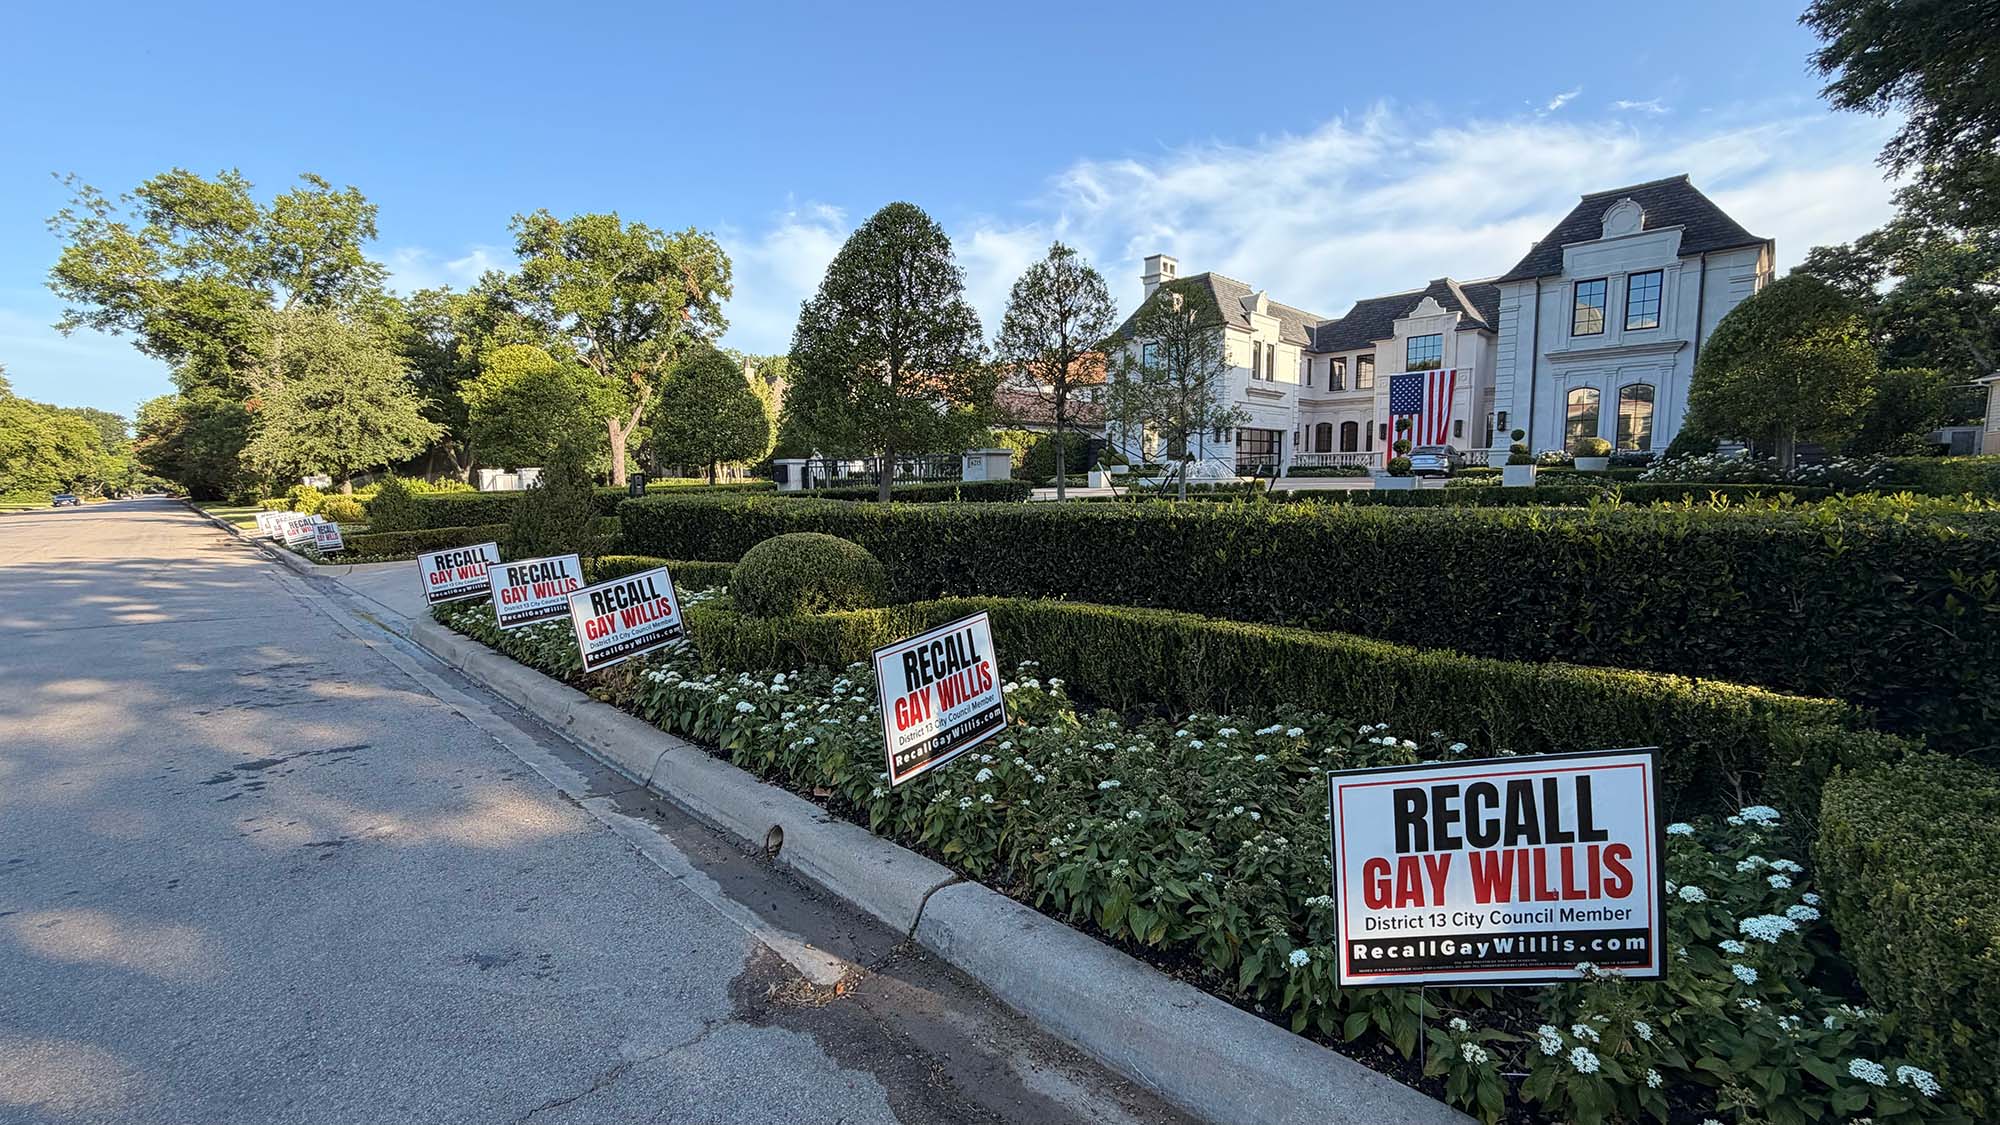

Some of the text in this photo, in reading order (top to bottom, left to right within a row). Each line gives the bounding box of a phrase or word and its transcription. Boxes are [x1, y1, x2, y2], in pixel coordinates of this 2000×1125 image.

[429, 563, 487, 585] GAY WILL
[434, 548, 489, 571] RECALL
[507, 561, 570, 587] RECALL
[500, 577, 578, 605] GAY WILLIS
[589, 577, 661, 617] RECALL
[585, 597, 672, 641] GAY WILLIS
[590, 639, 611, 650] District
[619, 631, 630, 640] City
[631, 625, 652, 636] Council
[652, 618, 674, 629] Member
[587, 626, 681, 661] RecallGayWillis.com
[902, 628, 981, 692] RECALL
[894, 660, 993, 732] GAY WILLIS
[895, 708, 1002, 767] RecallGayWillis.com
[898, 694, 995, 746] District 13 City Council Member
[1393, 775, 1609, 854] RECALL
[1363, 843, 1634, 911] GAY WILLIS
[1365, 906, 1633, 931] District 13 City Council Member
[1353, 935, 1646, 960] RecallGayWillis.com
